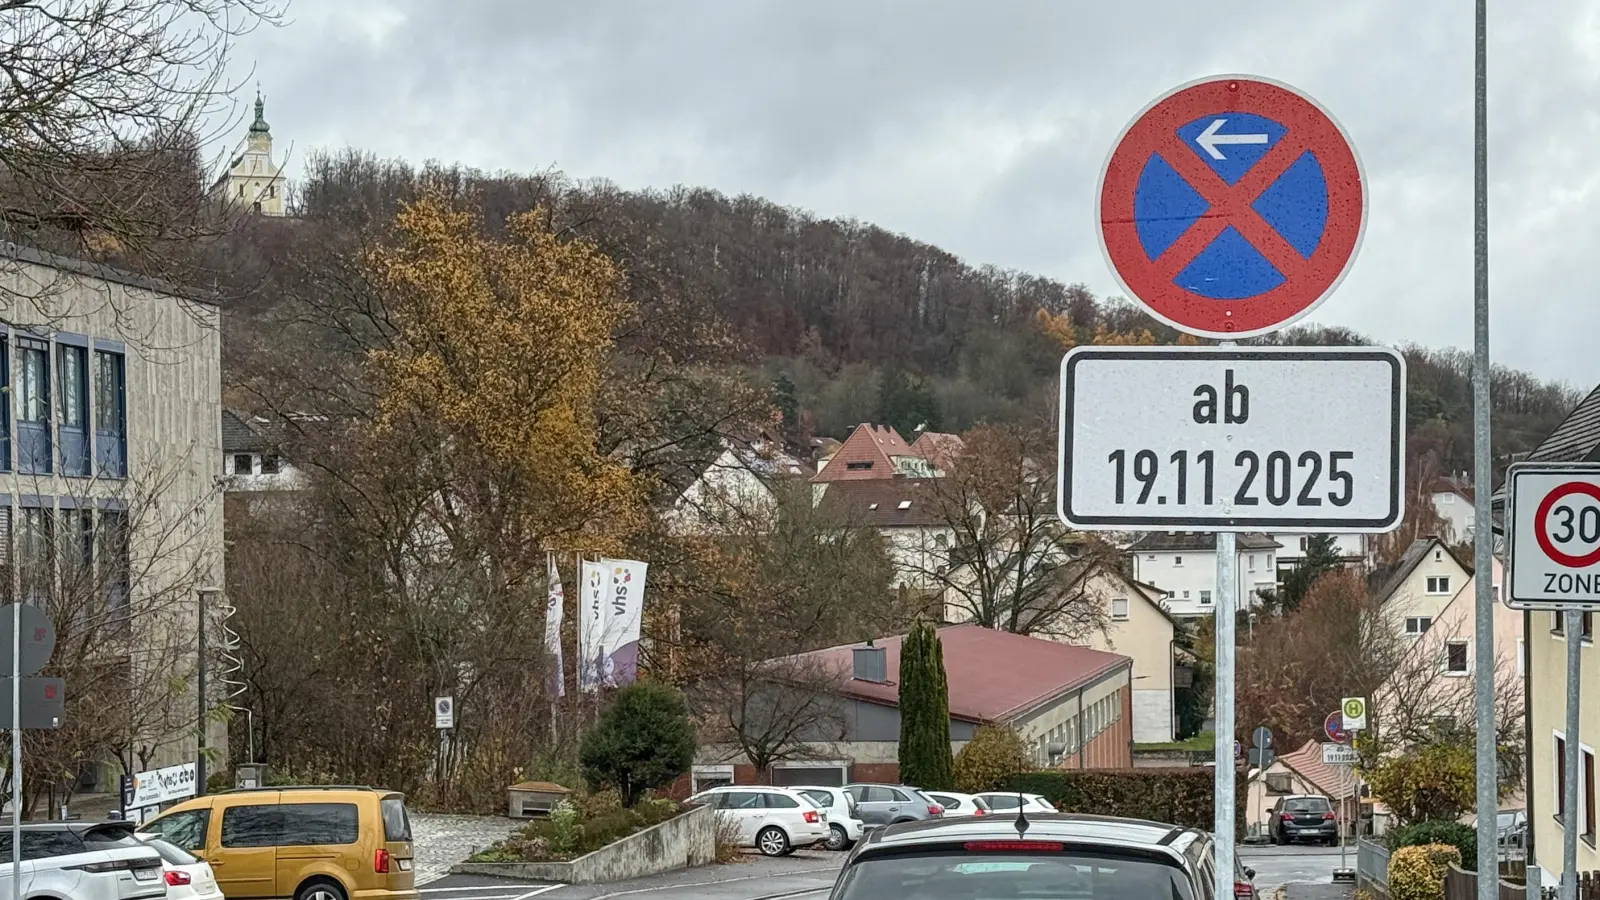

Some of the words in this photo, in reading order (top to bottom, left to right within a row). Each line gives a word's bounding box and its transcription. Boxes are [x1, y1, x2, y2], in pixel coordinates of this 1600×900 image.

[1192, 369, 1250, 424] ab
[1552, 505, 1600, 543] 30
[612, 585, 628, 616] vhs
[1348, 703, 1359, 715] H
